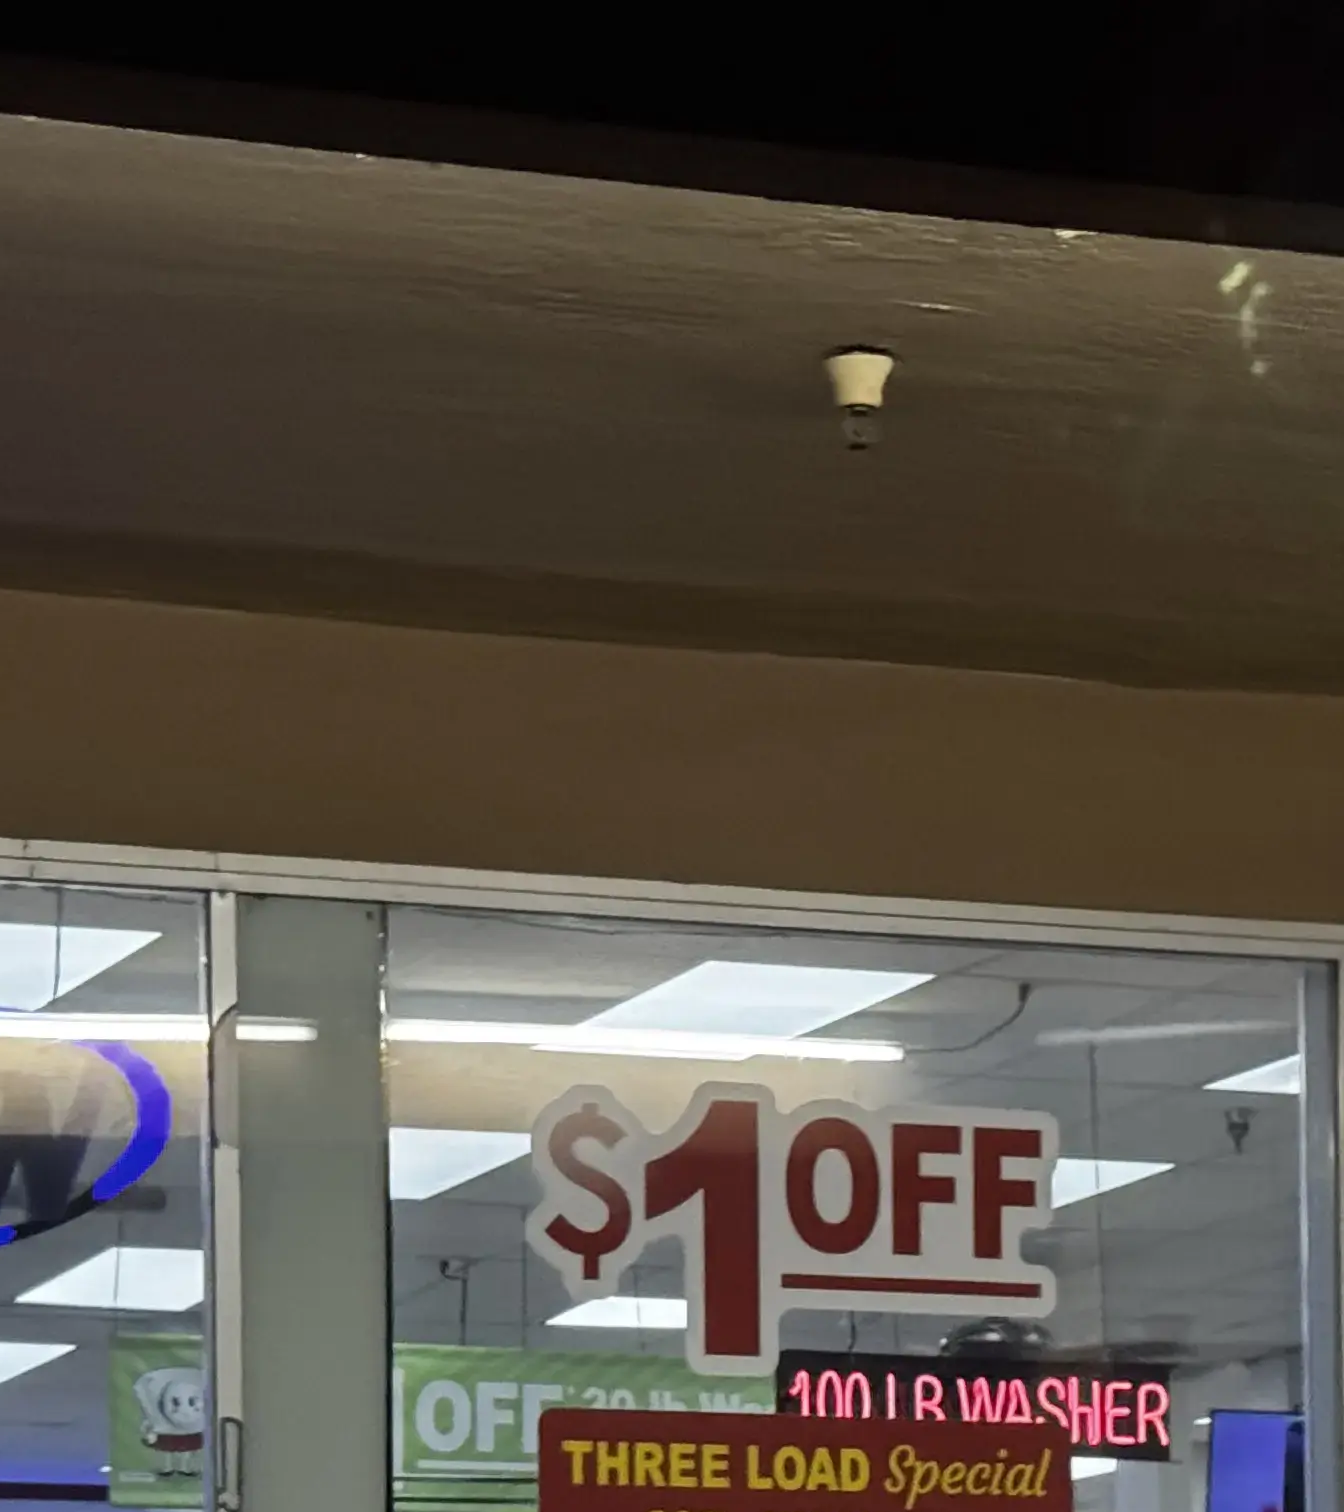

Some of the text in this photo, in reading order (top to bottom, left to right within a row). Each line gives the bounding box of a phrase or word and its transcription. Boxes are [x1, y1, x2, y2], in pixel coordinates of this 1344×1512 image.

[786, 1116, 1044, 1259] OFF
[561, 1440, 1053, 1509] THREE LOAD Special
